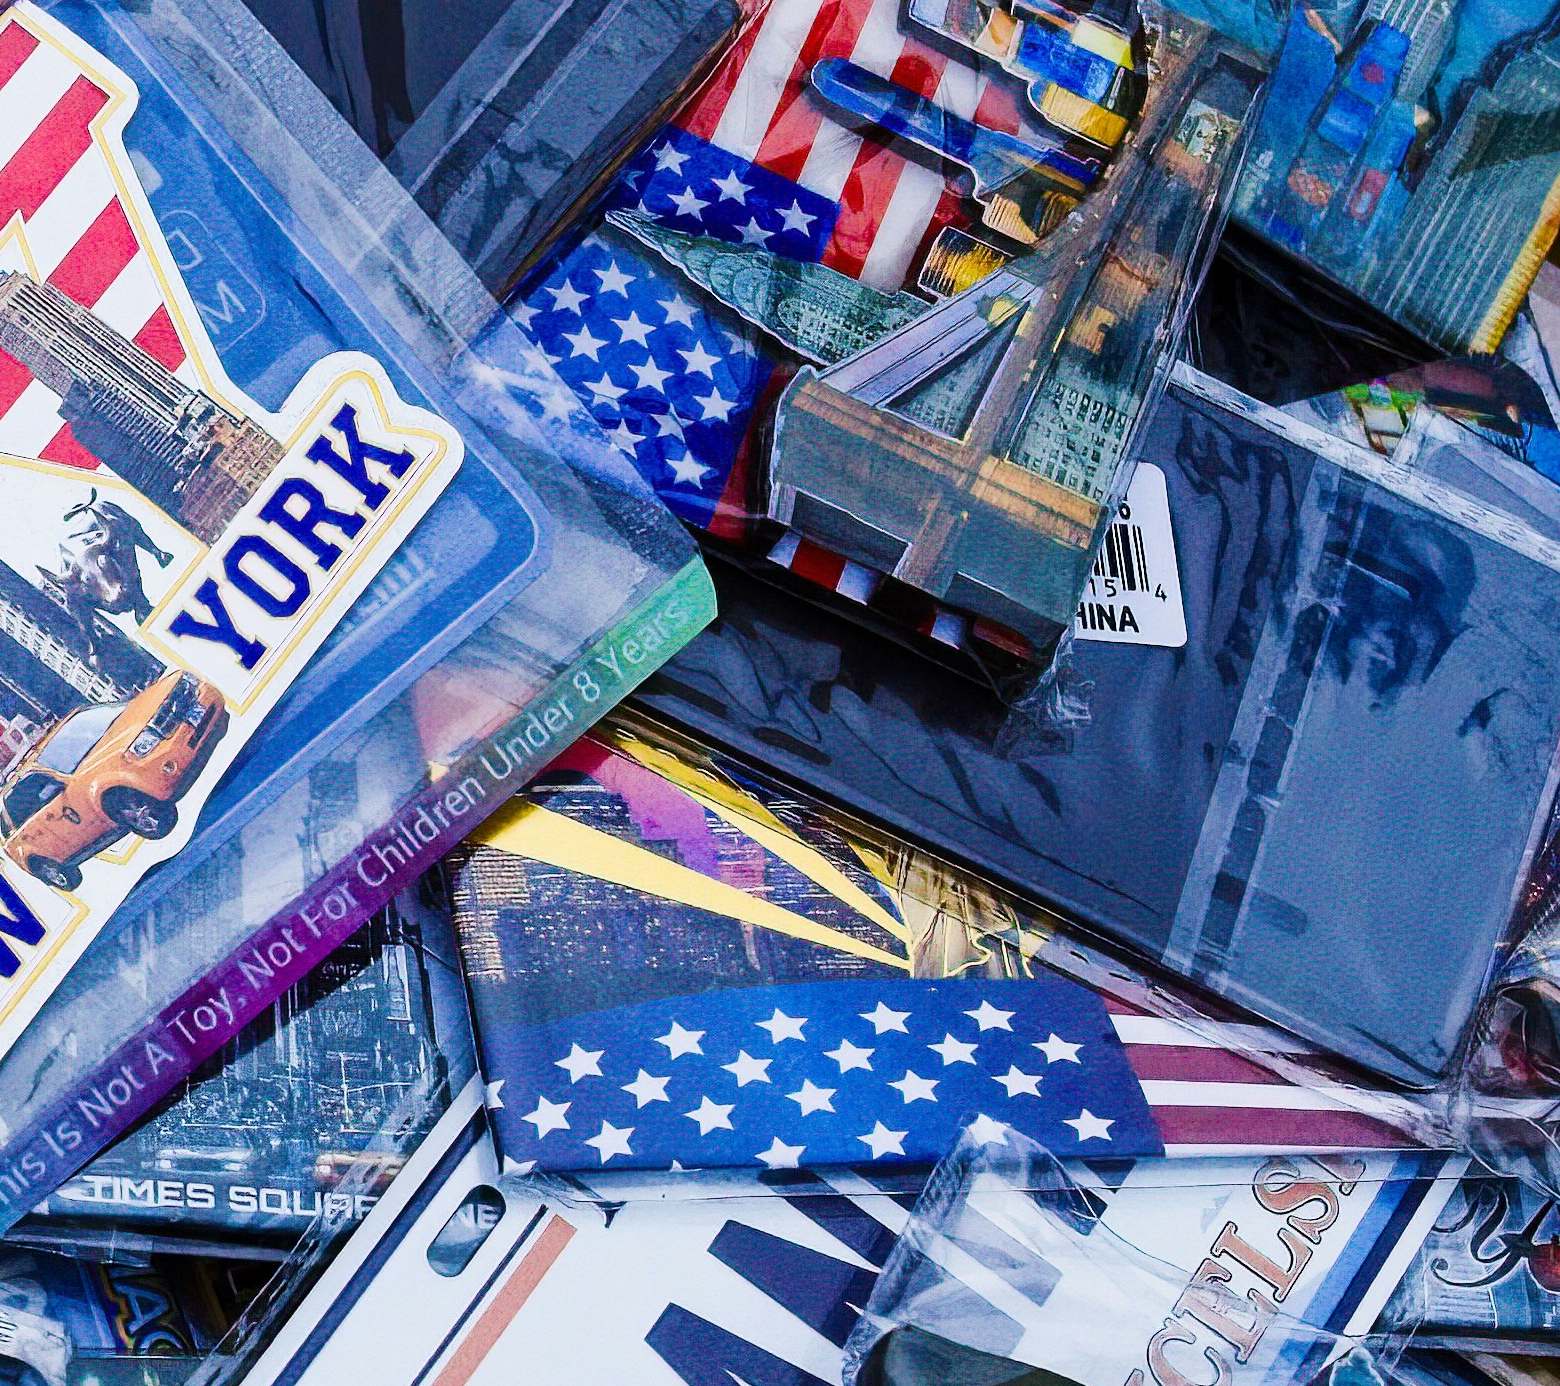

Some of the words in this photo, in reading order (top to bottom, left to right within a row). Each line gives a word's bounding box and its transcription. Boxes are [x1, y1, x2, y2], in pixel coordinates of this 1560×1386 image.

[166, 396, 437, 671] YORK
[1153, 584, 1168, 602] 4
[48, 1116, 86, 1158] Is
[80, 1071, 132, 1127] Not
[140, 1039, 177, 1074] A
[171, 987, 247, 1057] Toy,
[245, 926, 307, 982] Not
[300, 877, 364, 940] For
[354, 775, 490, 894] Children
[480, 687, 585, 779] Under
[572, 665, 606, 708] 8
[596, 602, 691, 676] Years
[79, 1178, 218, 1213] TIMES
